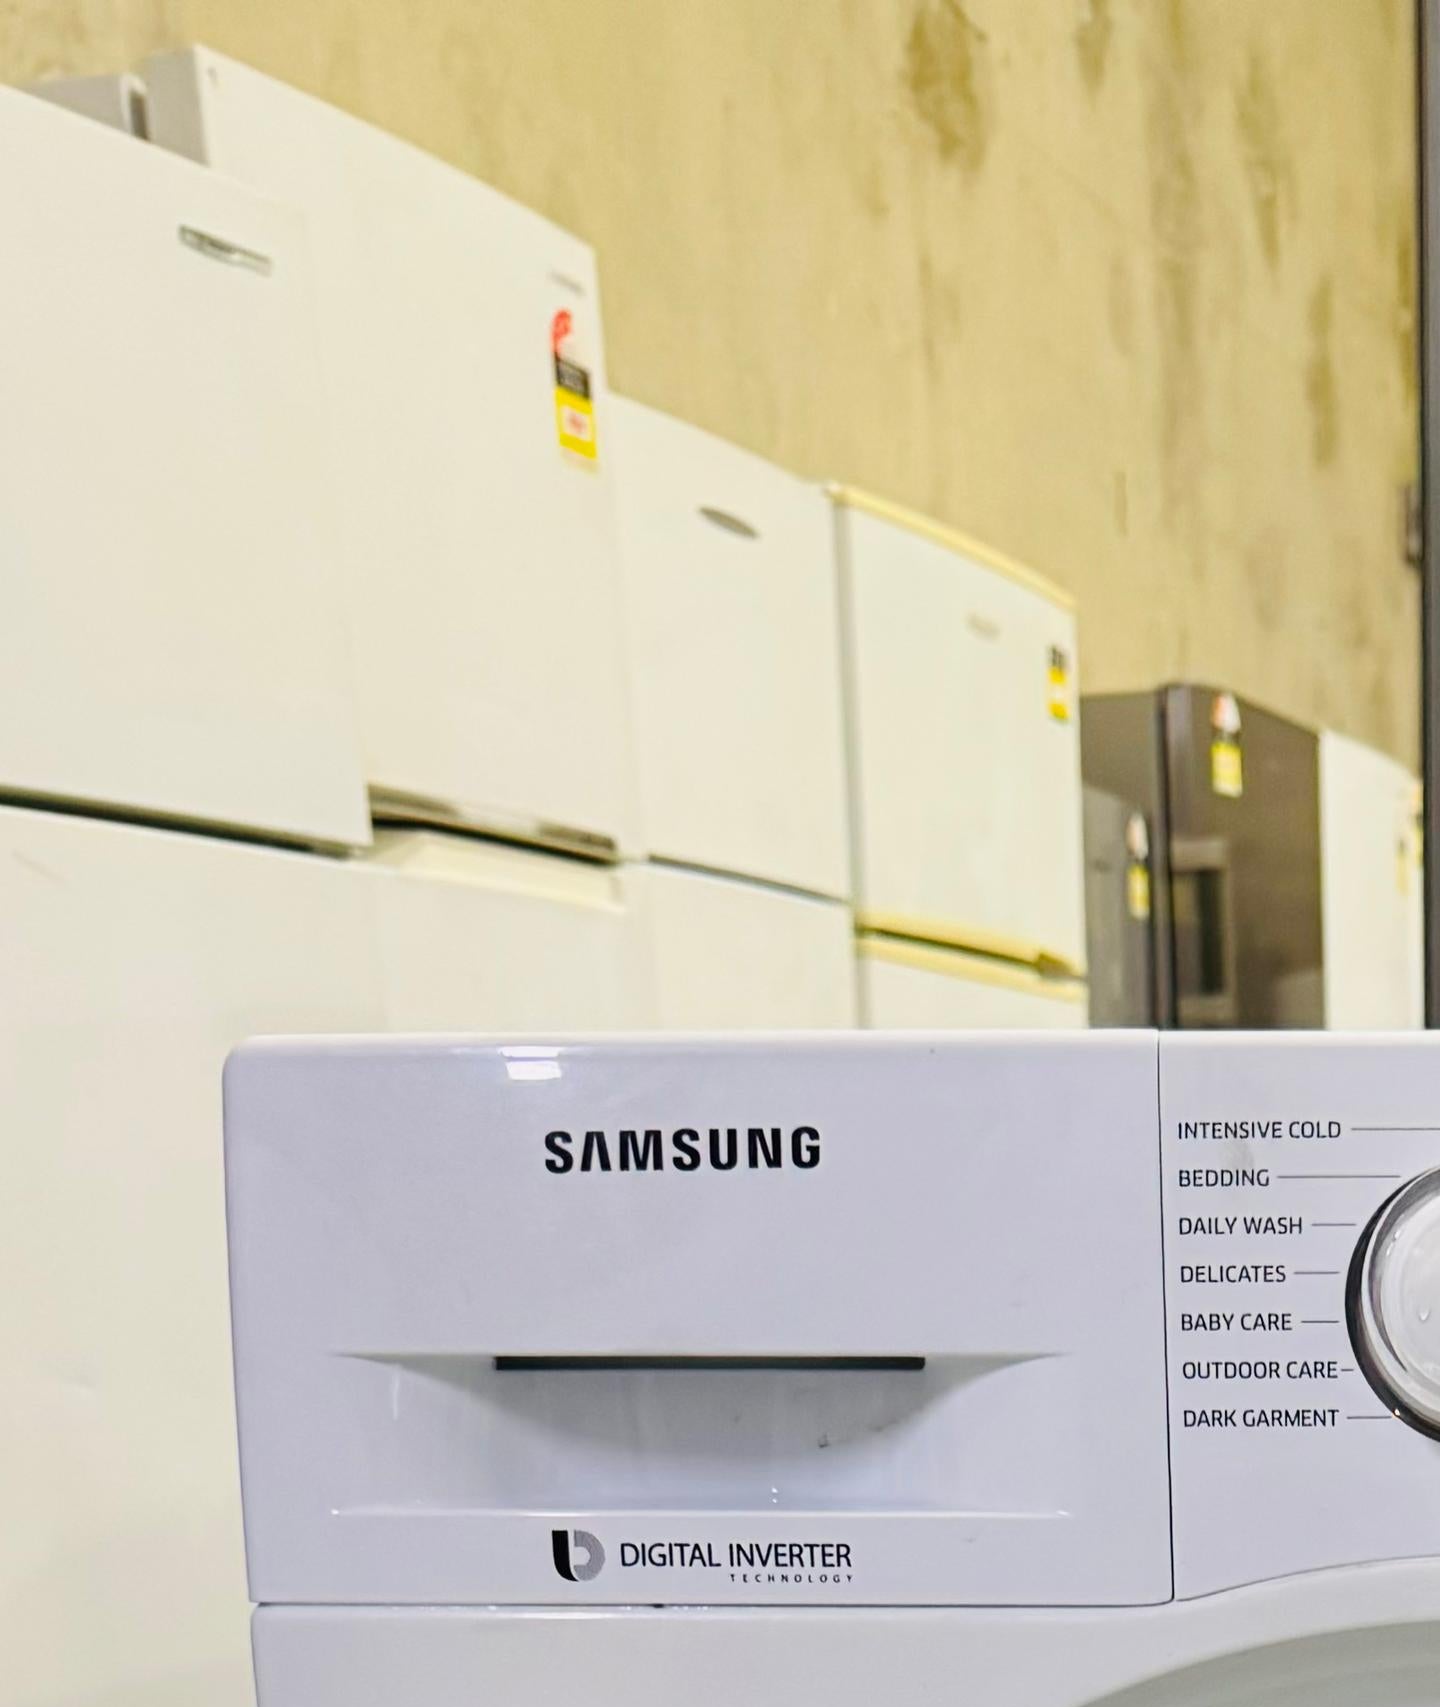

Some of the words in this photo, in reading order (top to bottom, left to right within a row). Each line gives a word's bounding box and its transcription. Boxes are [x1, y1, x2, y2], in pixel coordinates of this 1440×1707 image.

[1178, 1121, 1282, 1139] INTENSIVE
[1289, 1121, 1341, 1139] COLD
[545, 1126, 820, 1174] SAMSUNG
[1179, 1169, 1269, 1187] BEDDING
[1179, 1217, 1237, 1235] DAILY
[1243, 1217, 1302, 1234] WASH
[1181, 1265, 1286, 1283] DELICATES
[1181, 1313, 1234, 1331] BABY
[1241, 1313, 1292, 1331] CARE
[1183, 1361, 1280, 1379] OUTDOOR
[1287, 1361, 1338, 1379] CARE
[1184, 1410, 1237, 1427] DARK
[1243, 1409, 1339, 1427] GARMENT
[621, 1542, 722, 1567] DIGITAL
[729, 1543, 851, 1567] INVERTER
[730, 1574, 852, 1583] TECHNOLOGY
